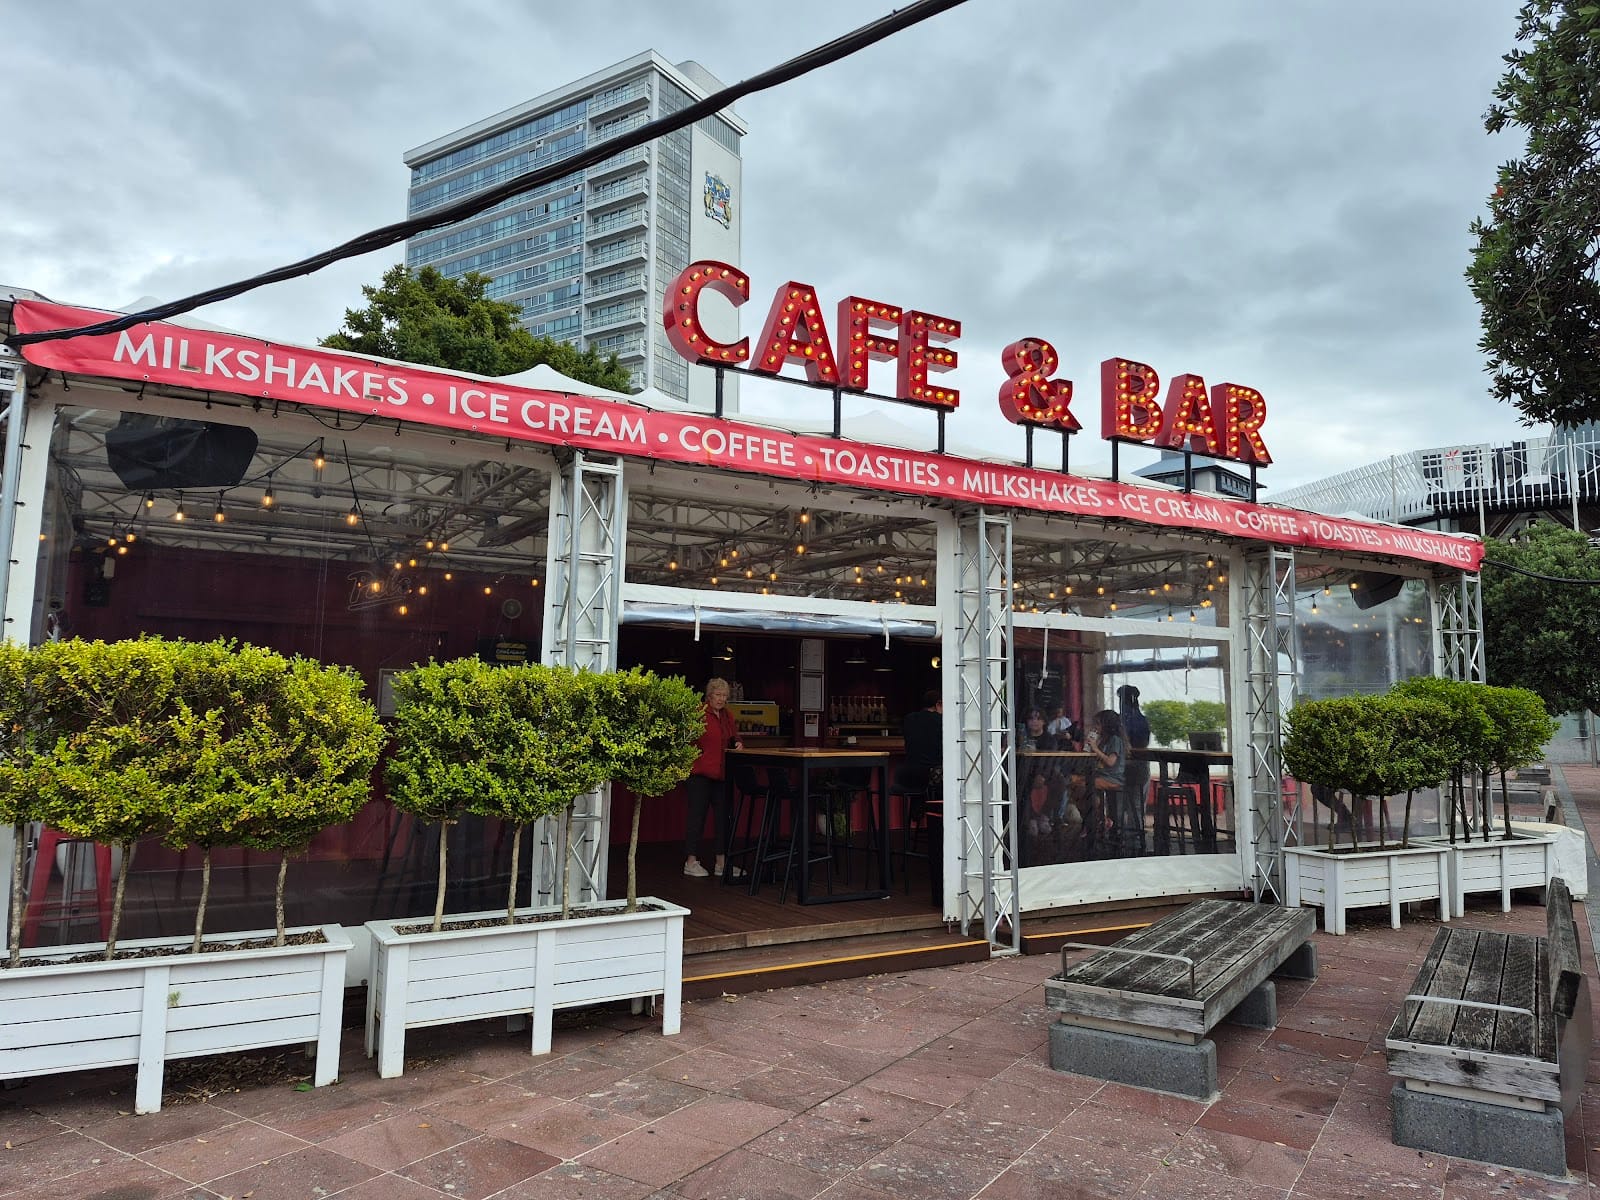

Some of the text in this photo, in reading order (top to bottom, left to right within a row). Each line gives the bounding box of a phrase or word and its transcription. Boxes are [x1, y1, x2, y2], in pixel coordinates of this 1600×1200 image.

[113, 330, 1472, 563] MILKSHAKES ICE CREAM COFFEE TOASTIES MILKSHAKES ICE CREAM COFFEE TOASTIES MILKSHAKES
[663, 260, 1273, 464] CAFE & BAR
